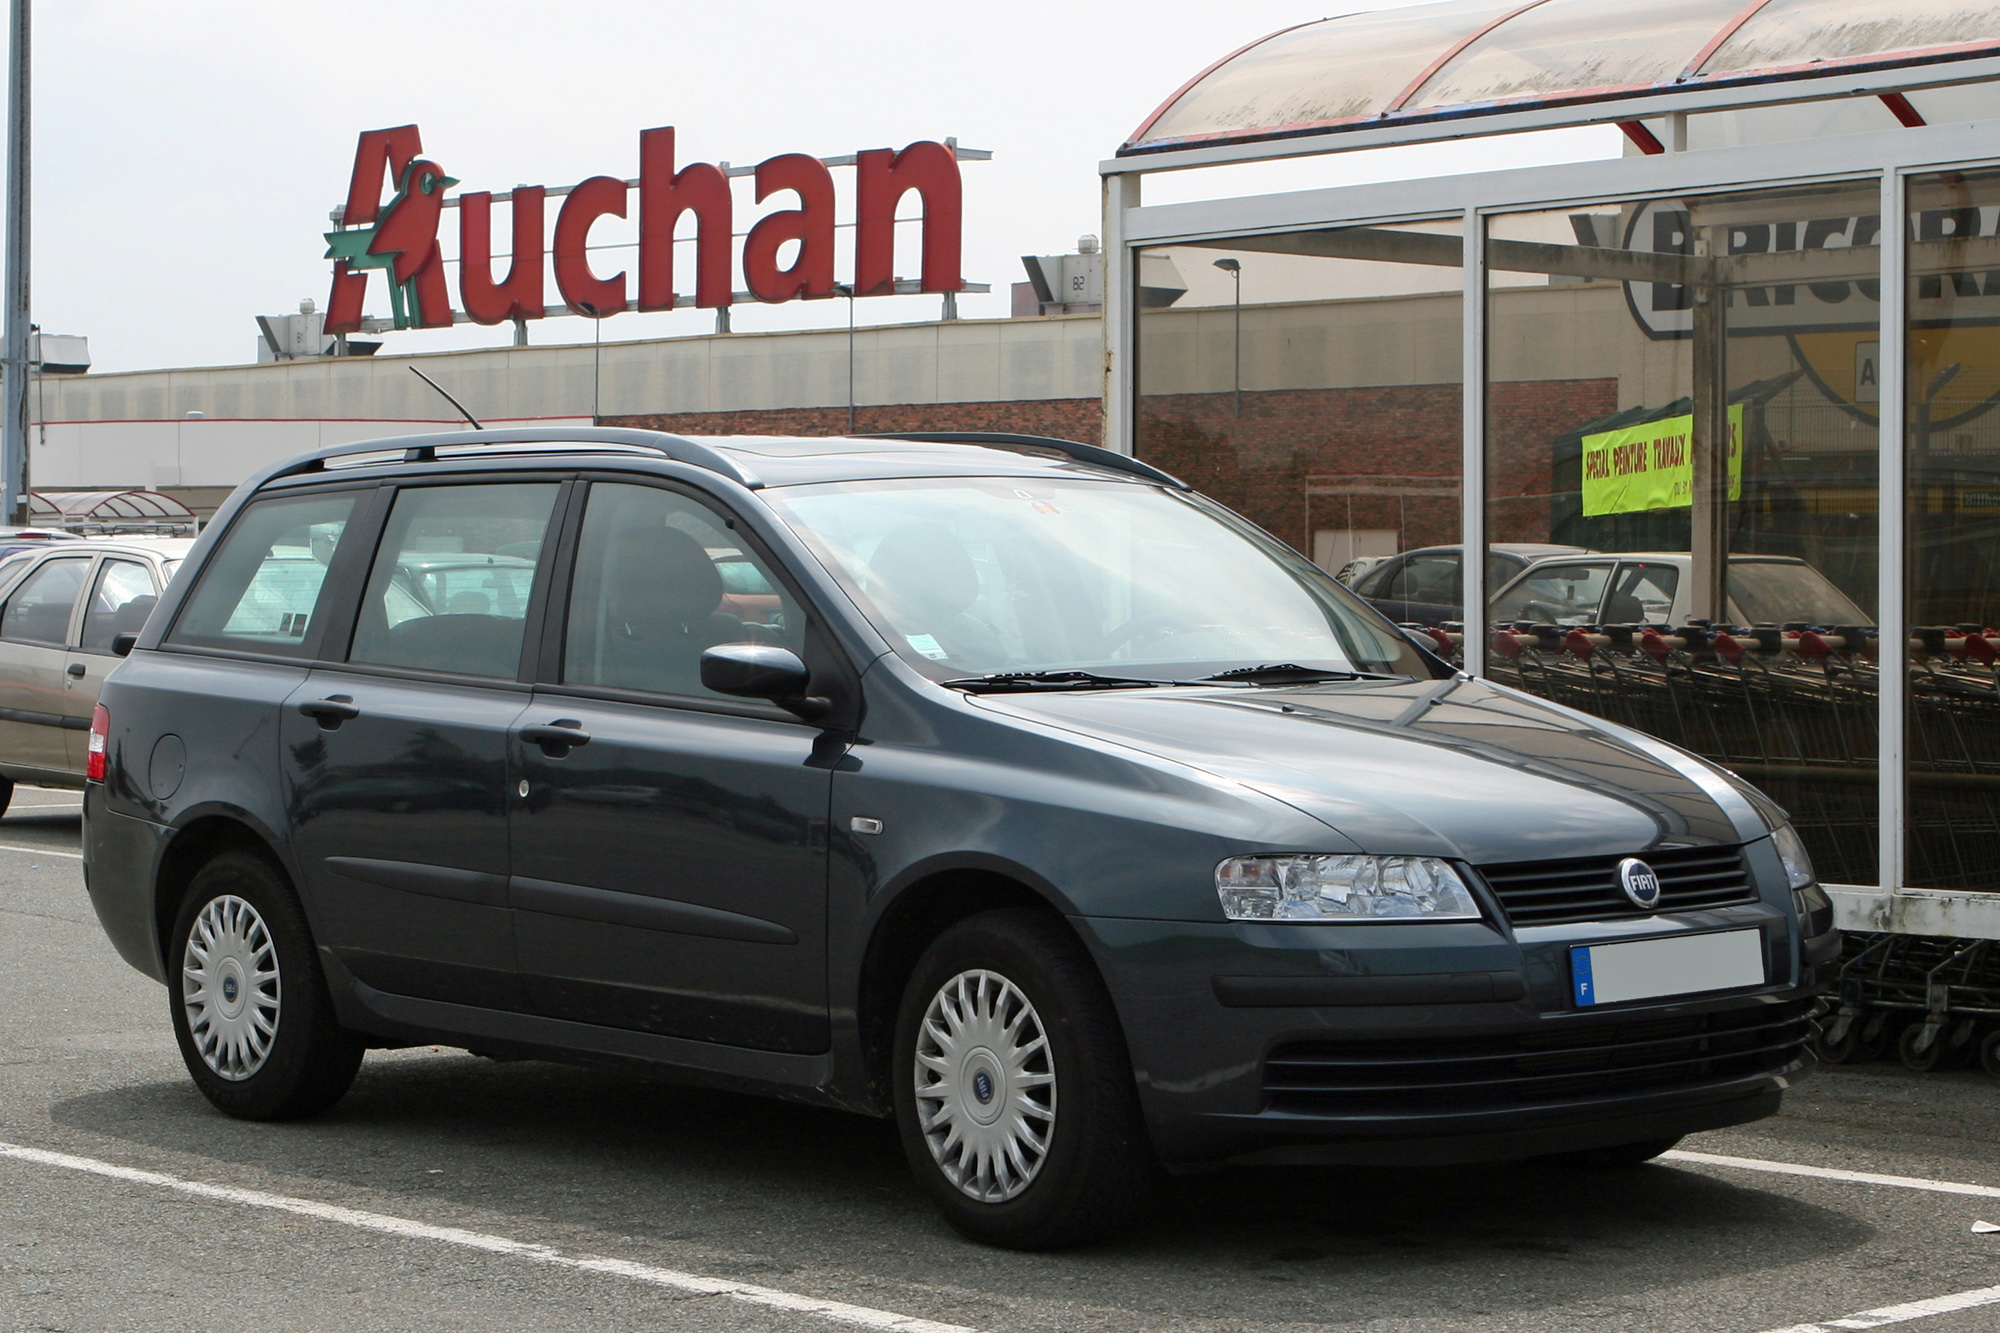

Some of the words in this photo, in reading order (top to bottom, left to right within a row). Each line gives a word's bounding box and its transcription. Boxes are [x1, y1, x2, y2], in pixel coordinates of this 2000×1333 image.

[323, 124, 962, 335] Auchan
[1073, 276, 1085, 291] B2
[1613, 441, 1647, 477] PEINTURE
[1653, 434, 1686, 470] TRAVAUX
[1629, 873, 1656, 892] FIAT
[1581, 982, 1588, 996] F
[977, 1076, 990, 1099] FIAT
